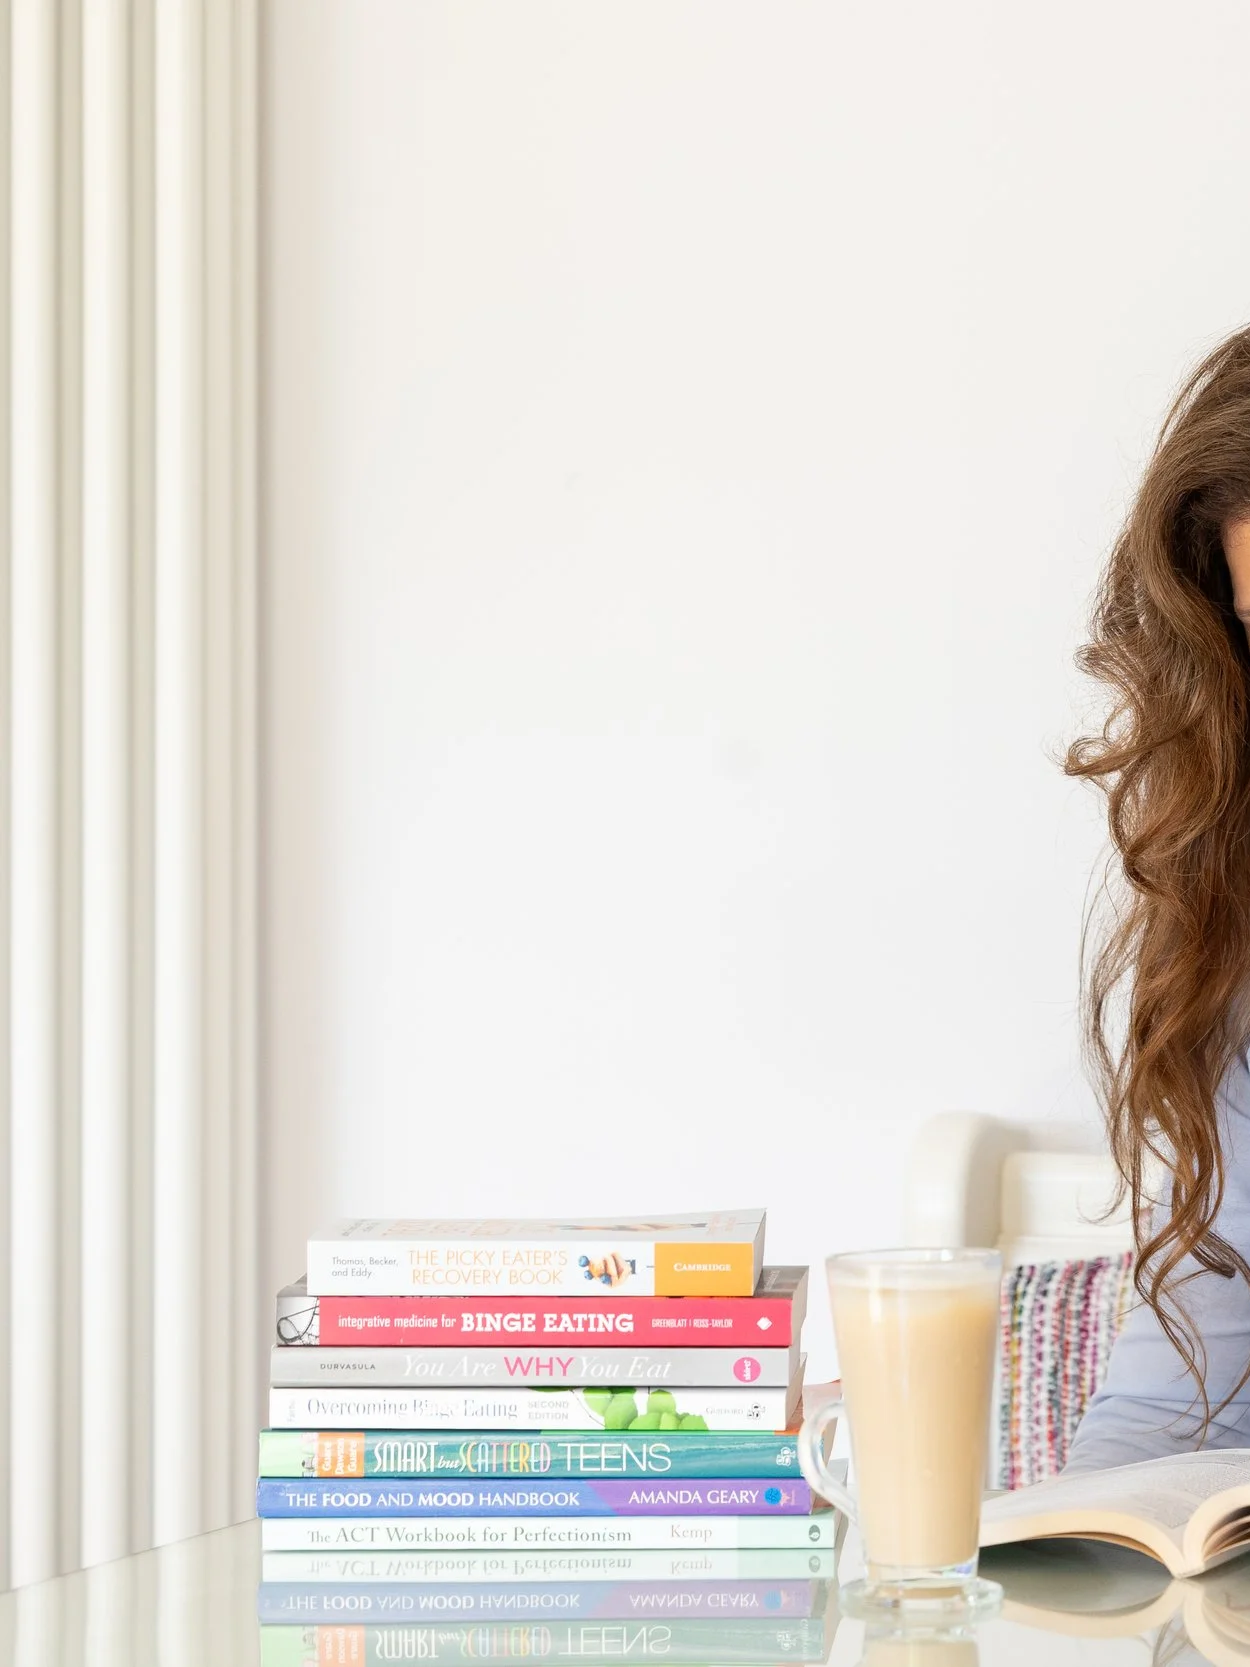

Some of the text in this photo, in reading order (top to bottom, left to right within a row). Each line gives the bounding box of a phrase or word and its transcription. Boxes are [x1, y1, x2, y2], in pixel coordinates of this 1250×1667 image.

[332, 1256, 399, 1268] Thomas, Becker,
[409, 1250, 568, 1266] THE PICKY EATER'S
[332, 1268, 372, 1278] and Eddy
[673, 1262, 732, 1272] CAMBRIDGE
[412, 1270, 563, 1285] RECOVERY BOOK
[338, 1313, 634, 1332] integrative medicine for BINGE EATING
[652, 1319, 733, 1328] GREENBLATT ROSS-TAYLOR
[403, 1355, 673, 1379] You Are WHY You Eat
[307, 1399, 518, 1418] Overcoming Binge Eating
[528, 1401, 569, 1409] SECOND
[528, 1411, 569, 1420] EDITION
[374, 1440, 672, 1473] SMART but SCATTERED TEENS
[286, 1492, 580, 1507] THE FOOD AND MOOD HANDBOOK
[628, 1490, 759, 1504] AMANDA GEARY
[307, 1526, 632, 1543] The ACT Workbook for Perfectionism
[670, 1524, 713, 1542] Kemp
